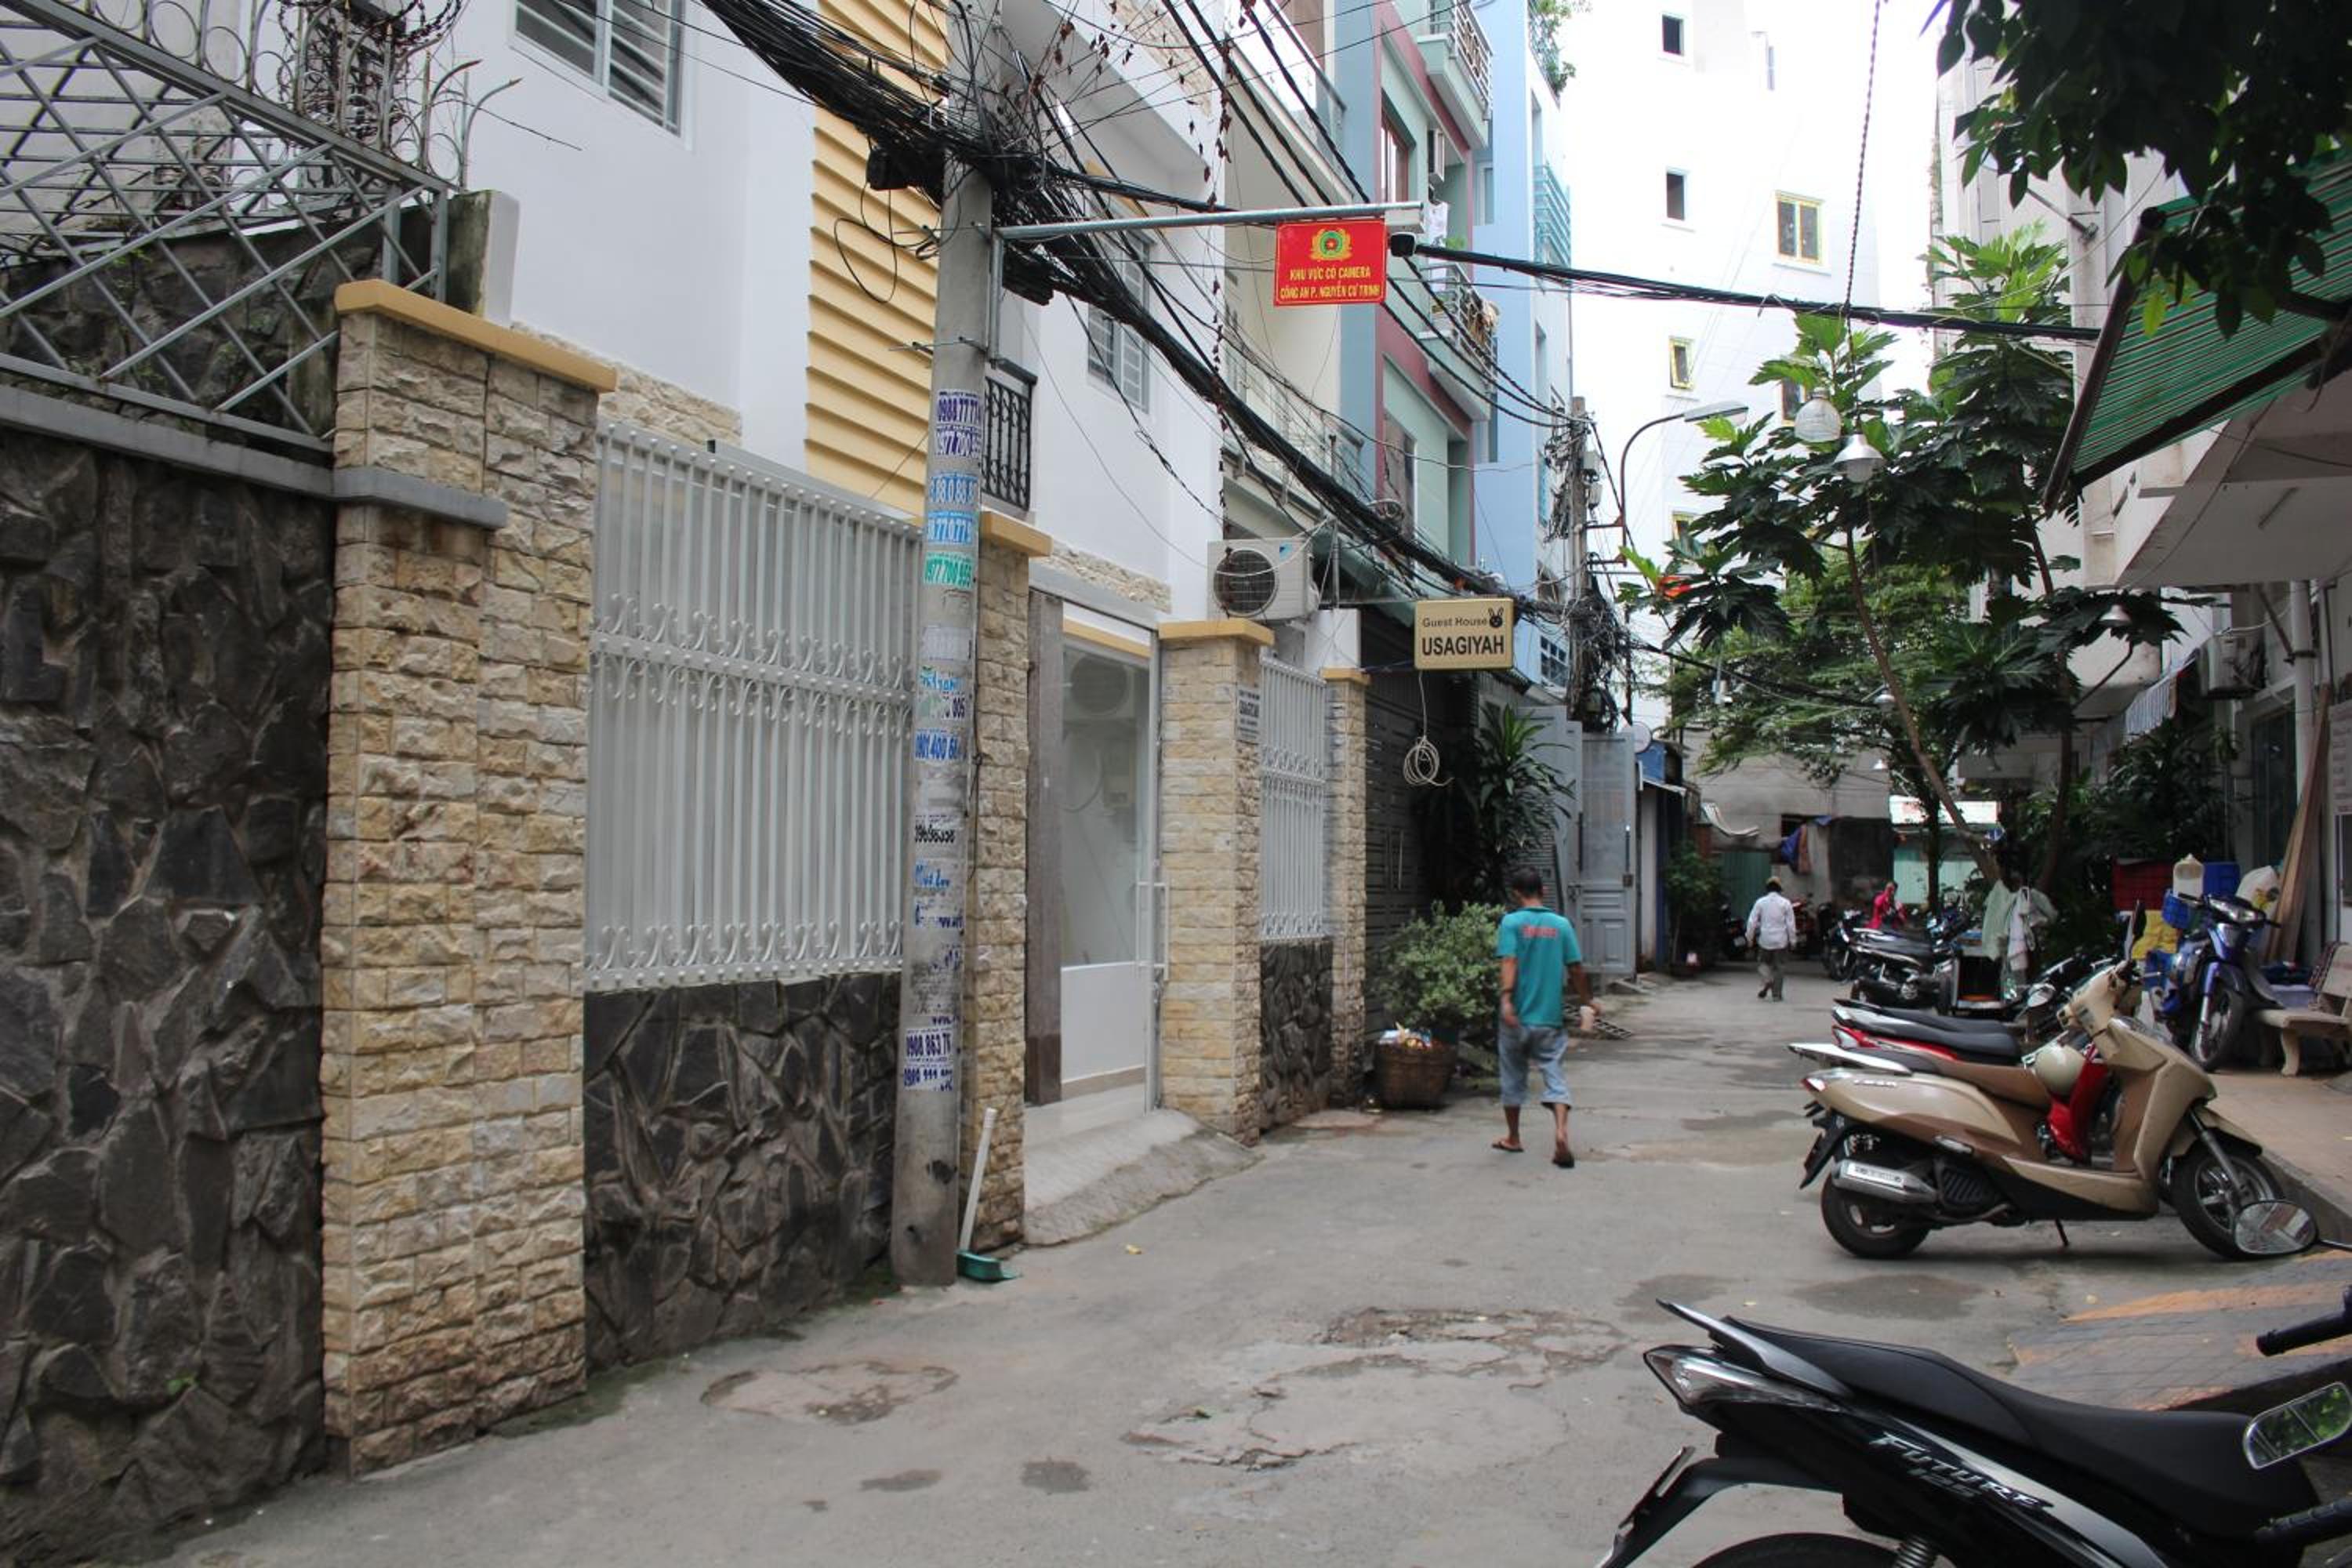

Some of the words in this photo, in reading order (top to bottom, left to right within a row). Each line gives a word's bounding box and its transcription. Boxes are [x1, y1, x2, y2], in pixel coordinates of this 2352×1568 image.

[1290, 268, 1305, 281] KHU
[1338, 266, 1371, 279] CAMERA
[1279, 285, 1298, 299] CÔNG
[1300, 286, 1310, 298] AN
[1359, 284, 1380, 296] TRINH
[1422, 617, 1453, 628] Guest
[1454, 615, 1487, 627] House
[1421, 635, 1504, 656] USAGIYAH
[1869, 1431, 2039, 1506] FUTURE
